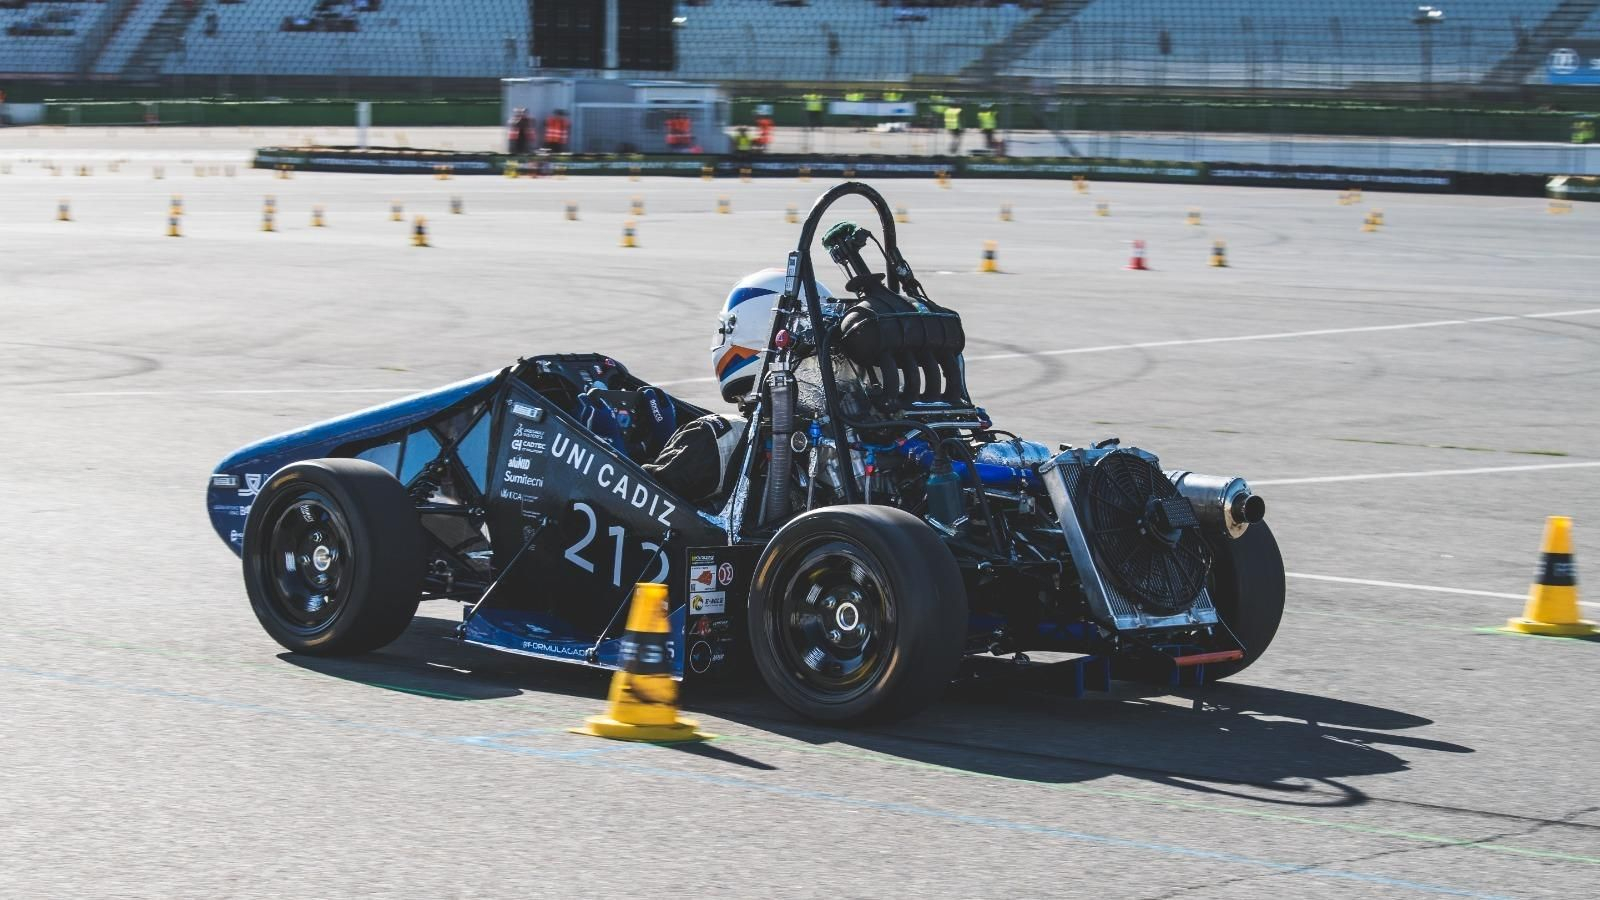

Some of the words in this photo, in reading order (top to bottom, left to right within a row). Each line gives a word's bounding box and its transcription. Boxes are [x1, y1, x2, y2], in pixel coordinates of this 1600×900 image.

[504, 470, 545, 487] Sumitecni
[551, 432, 595, 475] UNI
[597, 463, 676, 527] CADIZ
